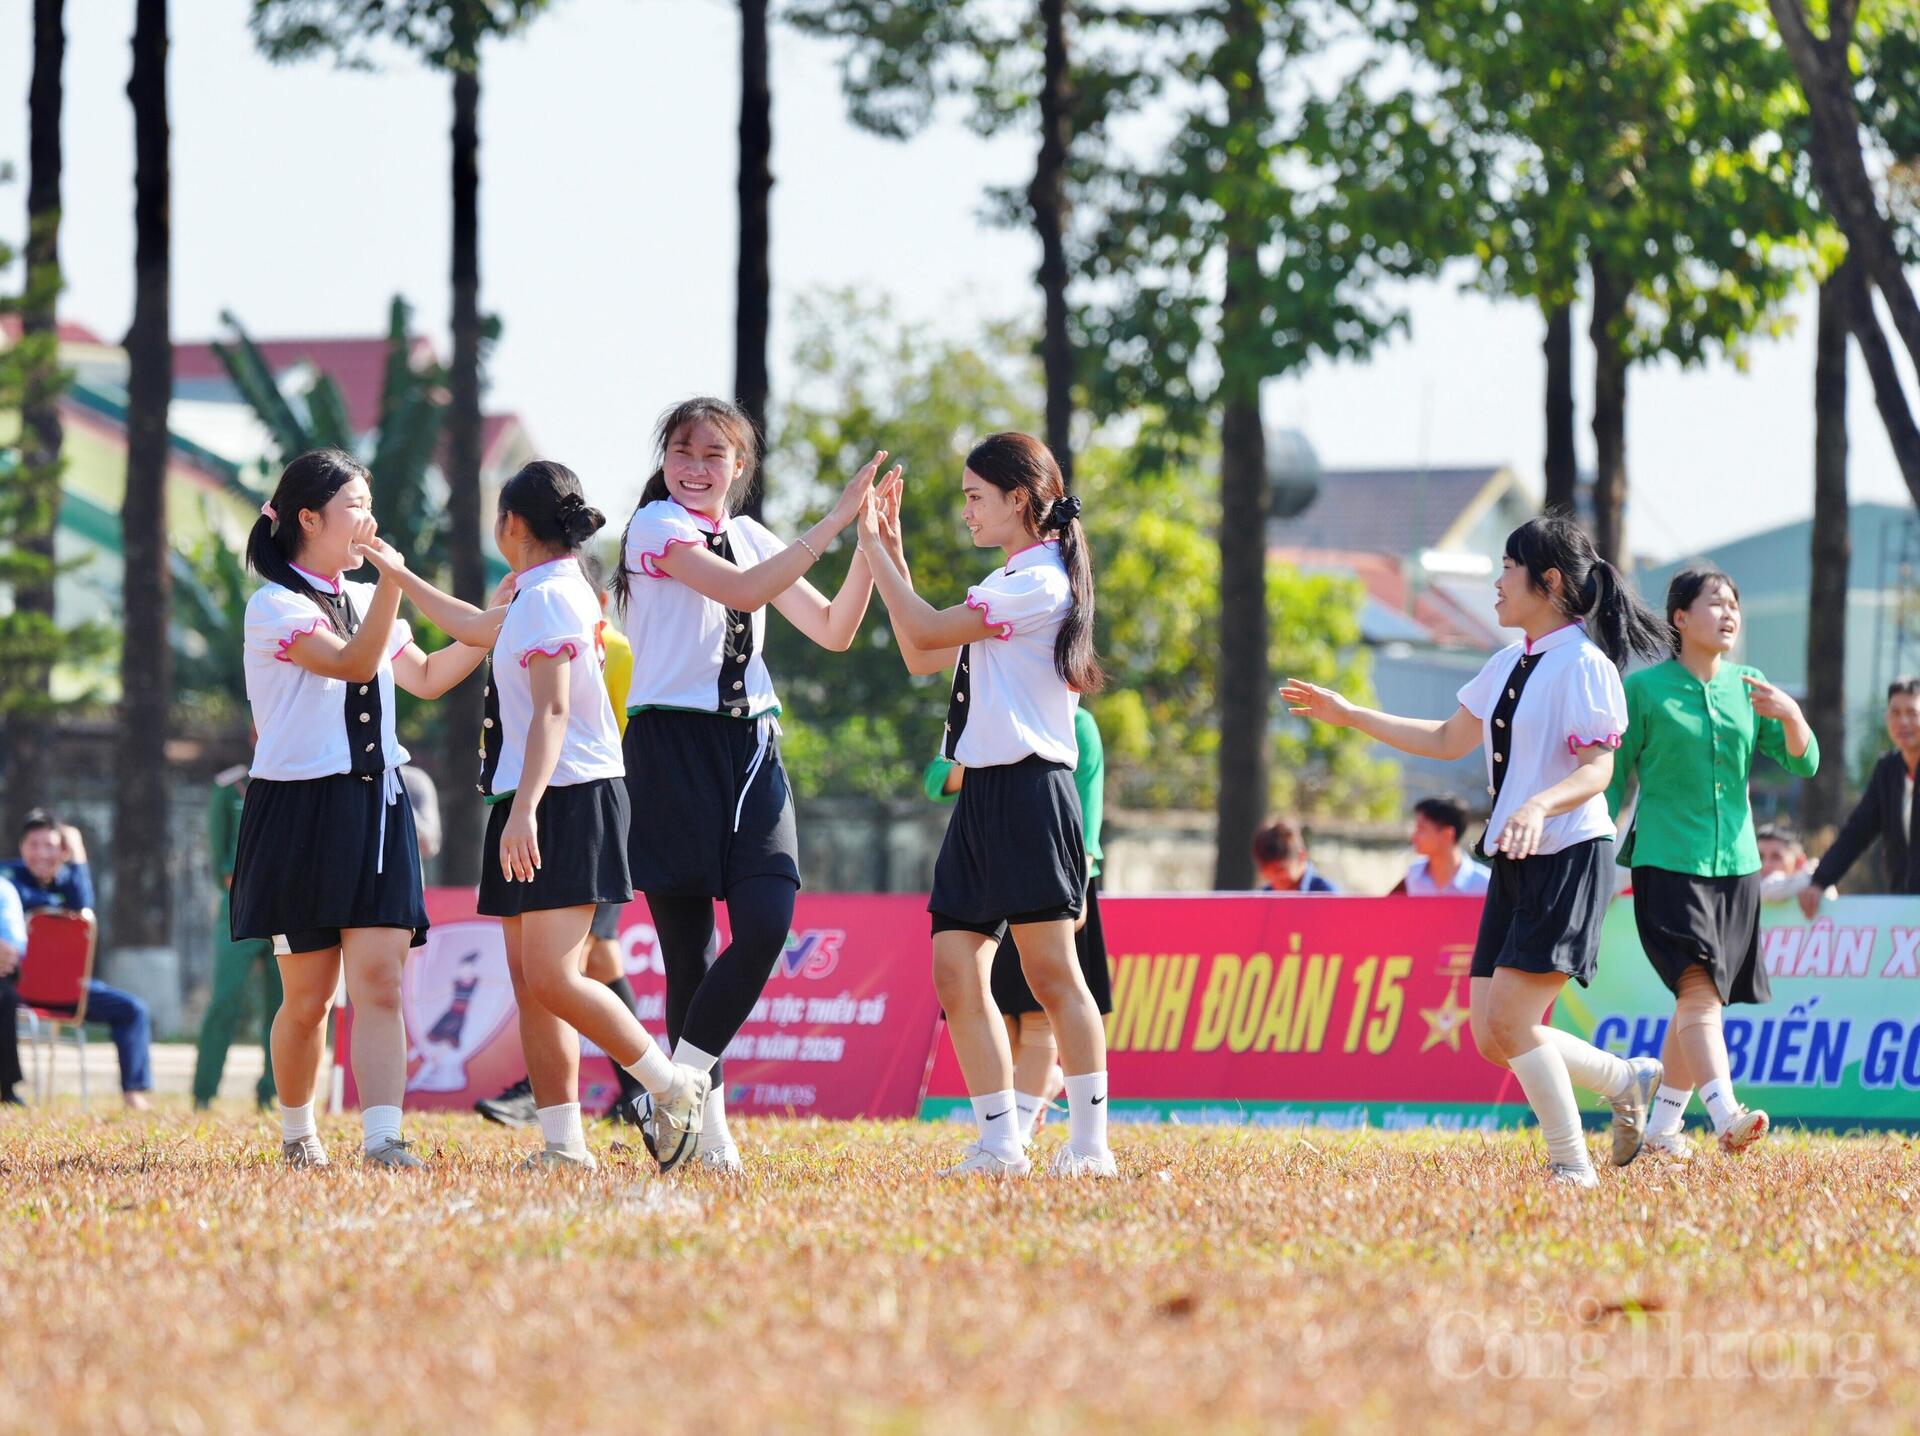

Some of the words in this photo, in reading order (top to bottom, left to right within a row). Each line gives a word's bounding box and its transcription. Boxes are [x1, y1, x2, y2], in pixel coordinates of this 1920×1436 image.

[1760, 917, 1876, 977] HÂN
[1104, 953, 1200, 1052] INH
[1192, 932, 1343, 1053] ĐOÀN
[1343, 955, 1413, 1055] 15
